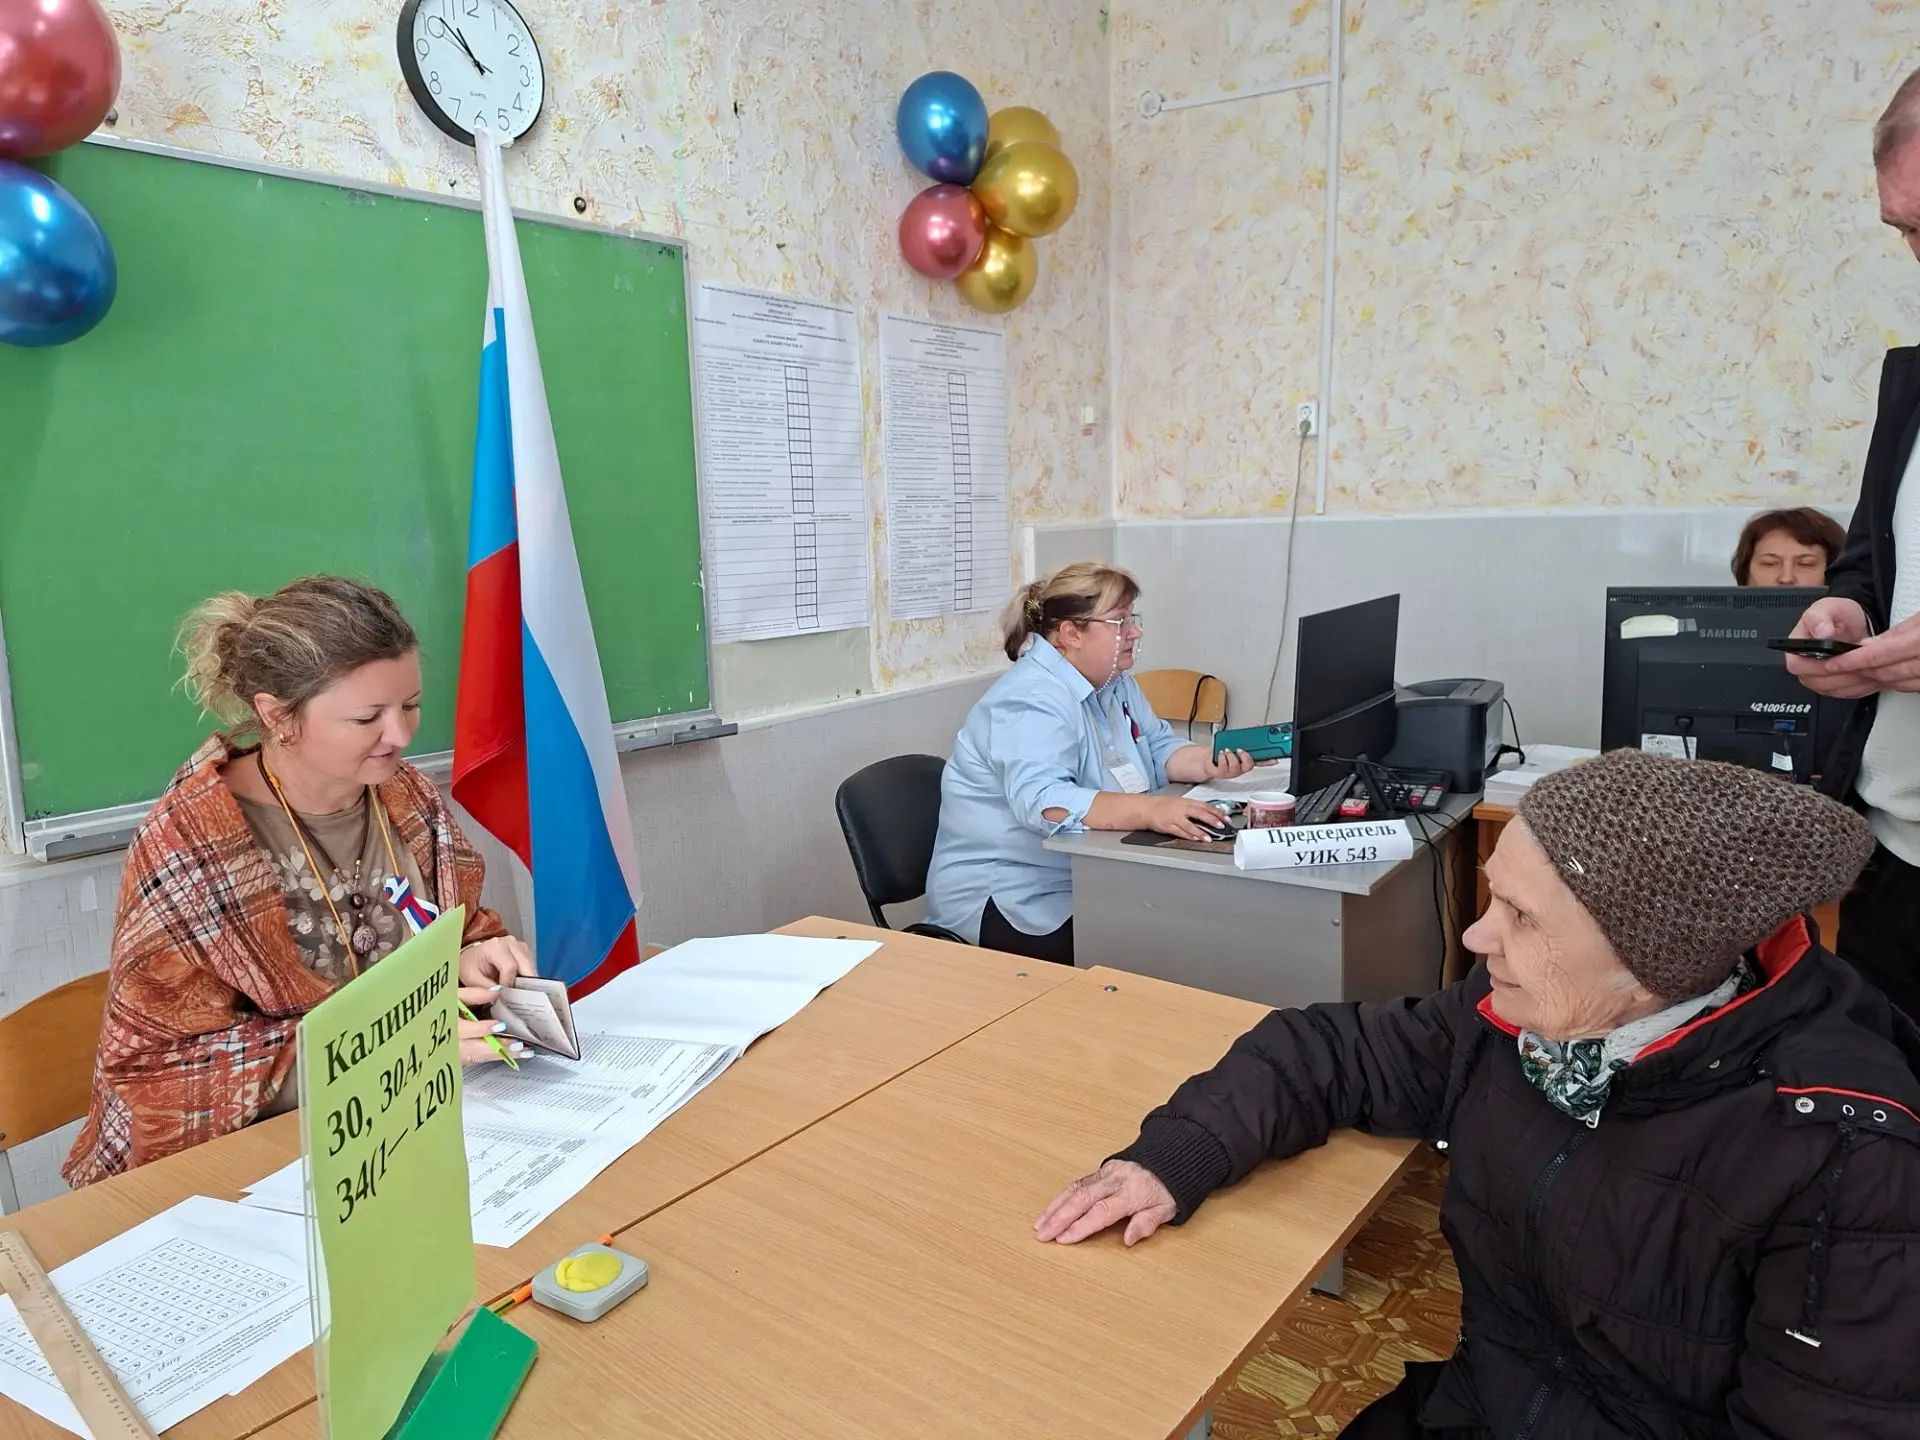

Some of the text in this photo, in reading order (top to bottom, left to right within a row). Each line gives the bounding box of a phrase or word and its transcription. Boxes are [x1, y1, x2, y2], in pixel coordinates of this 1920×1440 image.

[421, 12, 446, 39] 10
[491, 8, 497, 31] 1
[416, 38, 430, 61] 9
[506, 33, 521, 57] 2
[429, 70, 442, 95] 8
[519, 64, 531, 88] 3
[449, 97, 462, 120] 7
[511, 92, 524, 112] 4
[497, 108, 511, 131] 5
[1699, 628, 1758, 639] SAMSUNG
[1750, 702, 1812, 714] 4210051268
[1267, 823, 1397, 848] Председатель
[1294, 846, 1377, 866] УИК 543
[325, 960, 450, 1086] Калинина
[327, 1008, 452, 1157] 30, 30А, 32,
